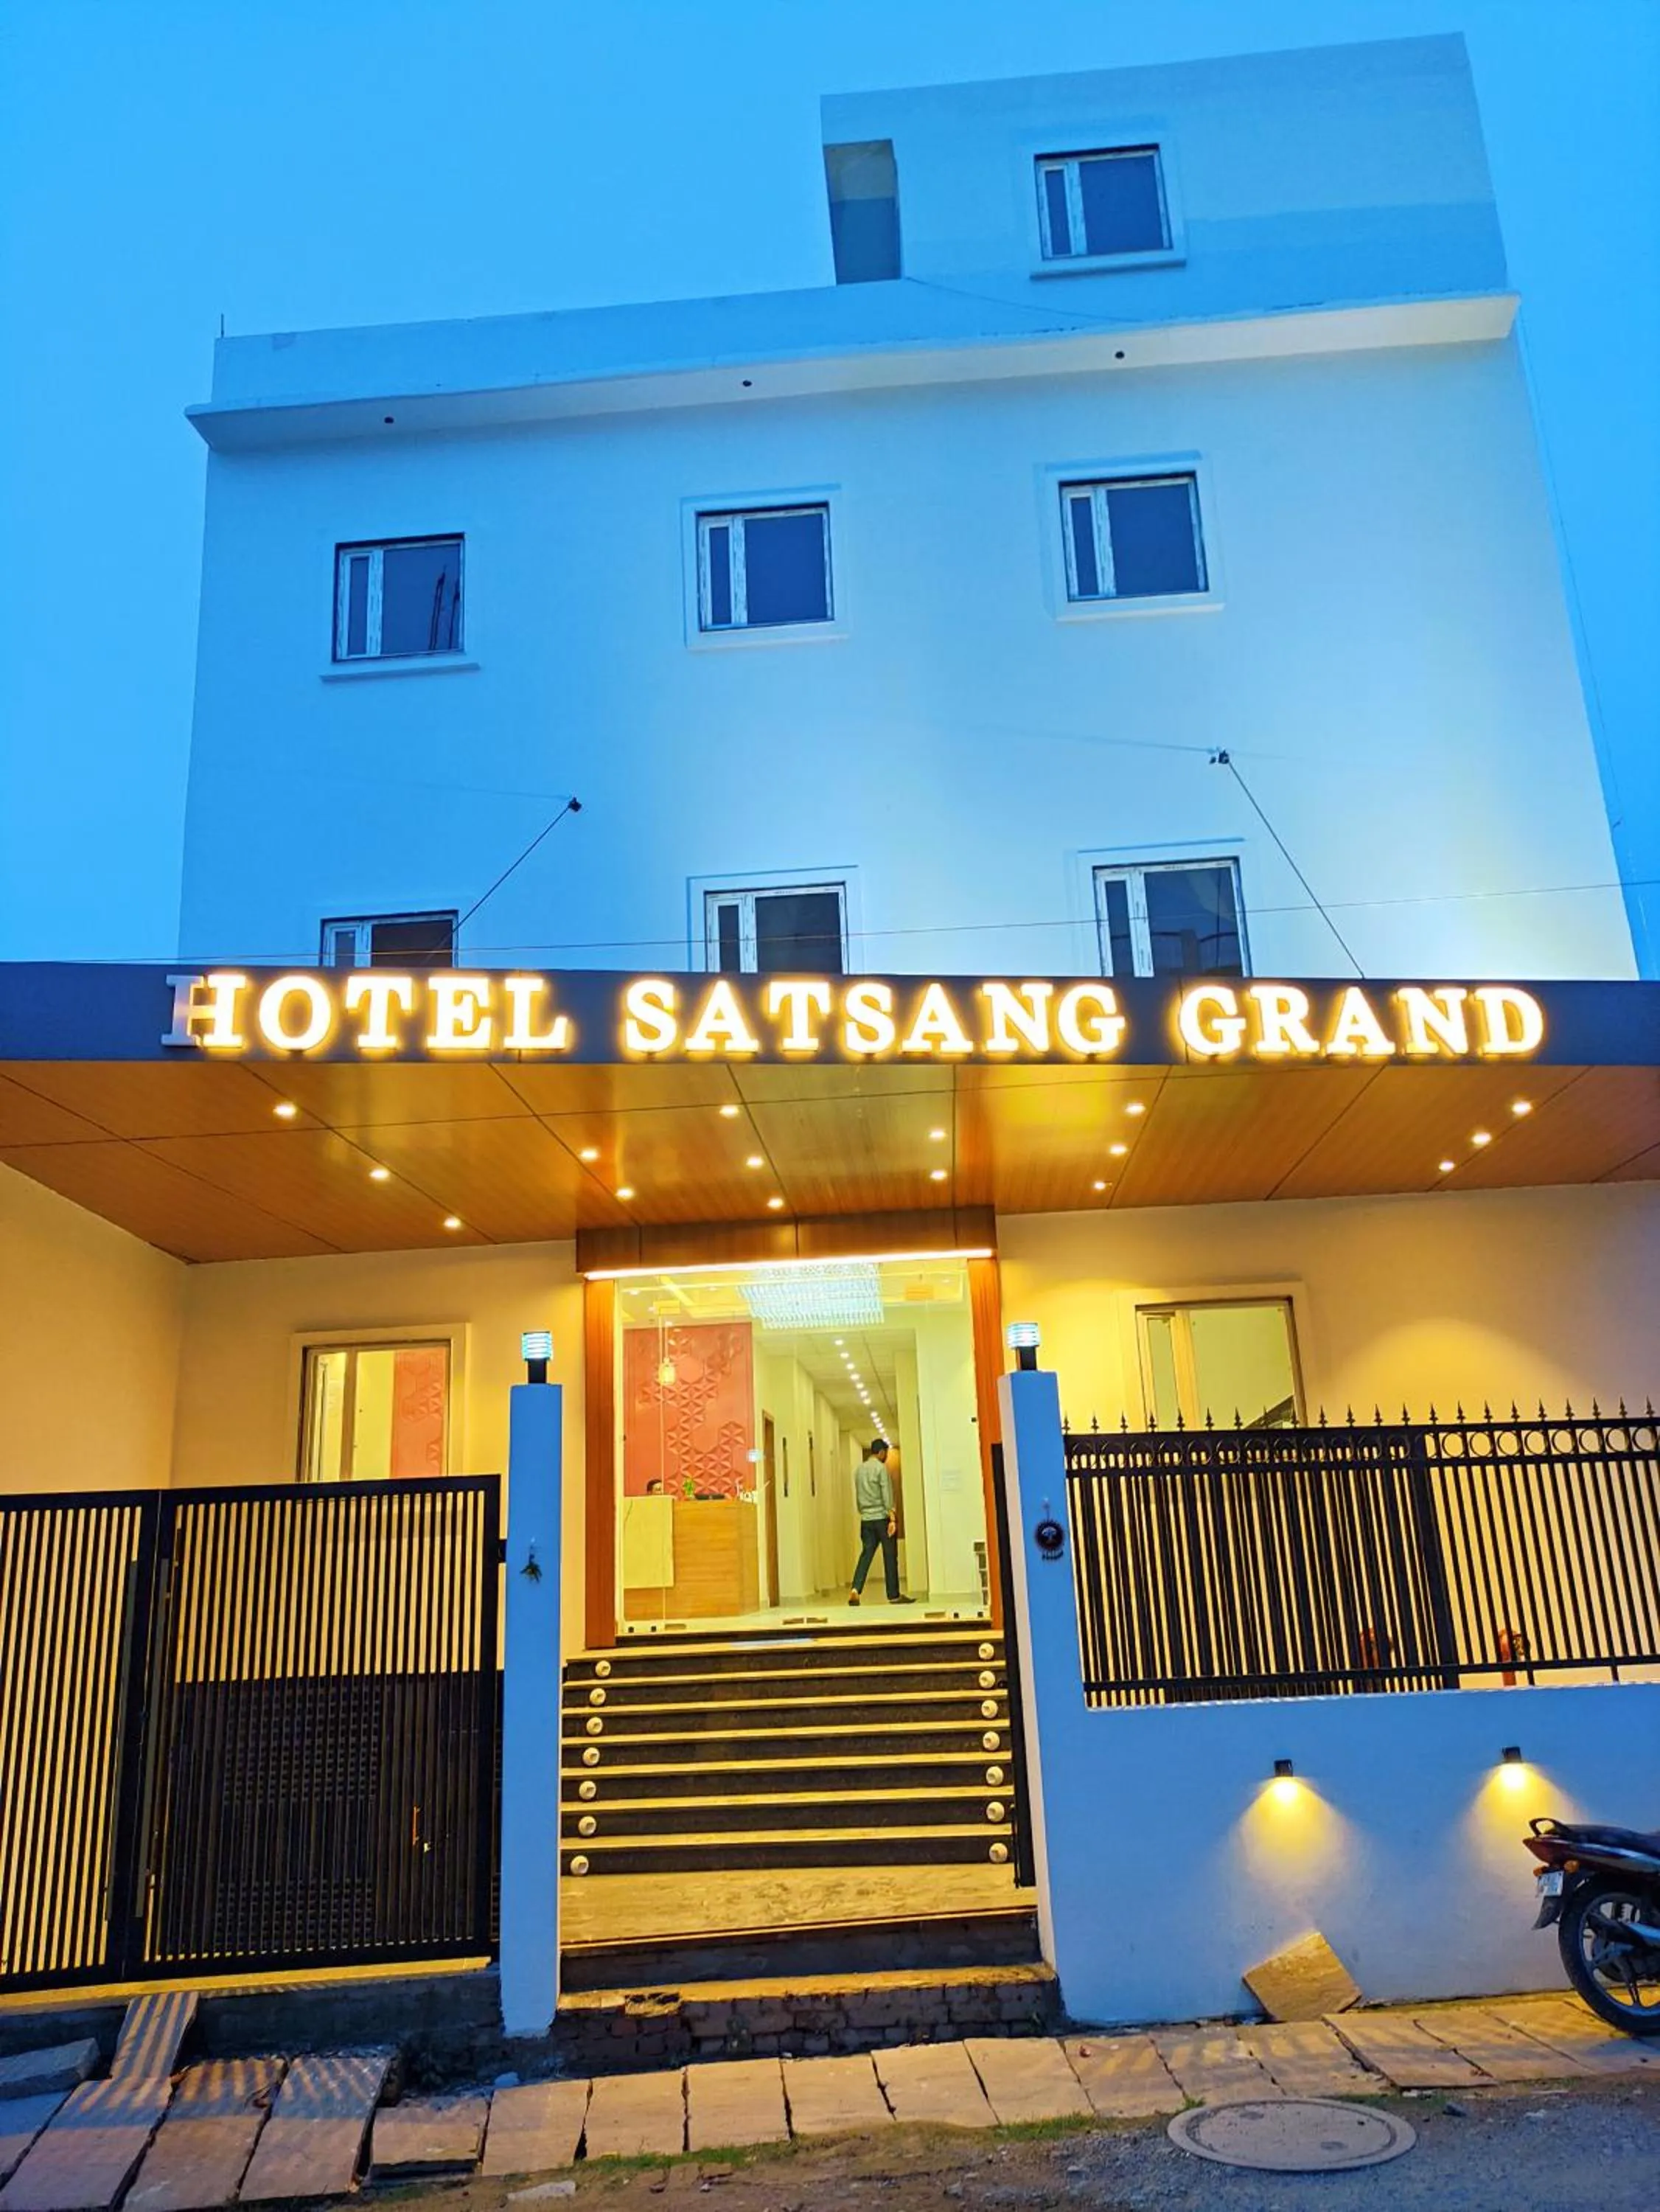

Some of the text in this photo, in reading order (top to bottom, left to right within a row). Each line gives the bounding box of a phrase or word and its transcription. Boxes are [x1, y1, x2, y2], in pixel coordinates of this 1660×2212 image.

[161, 973, 1544, 1057] HOTEL SATSANG GRAND
